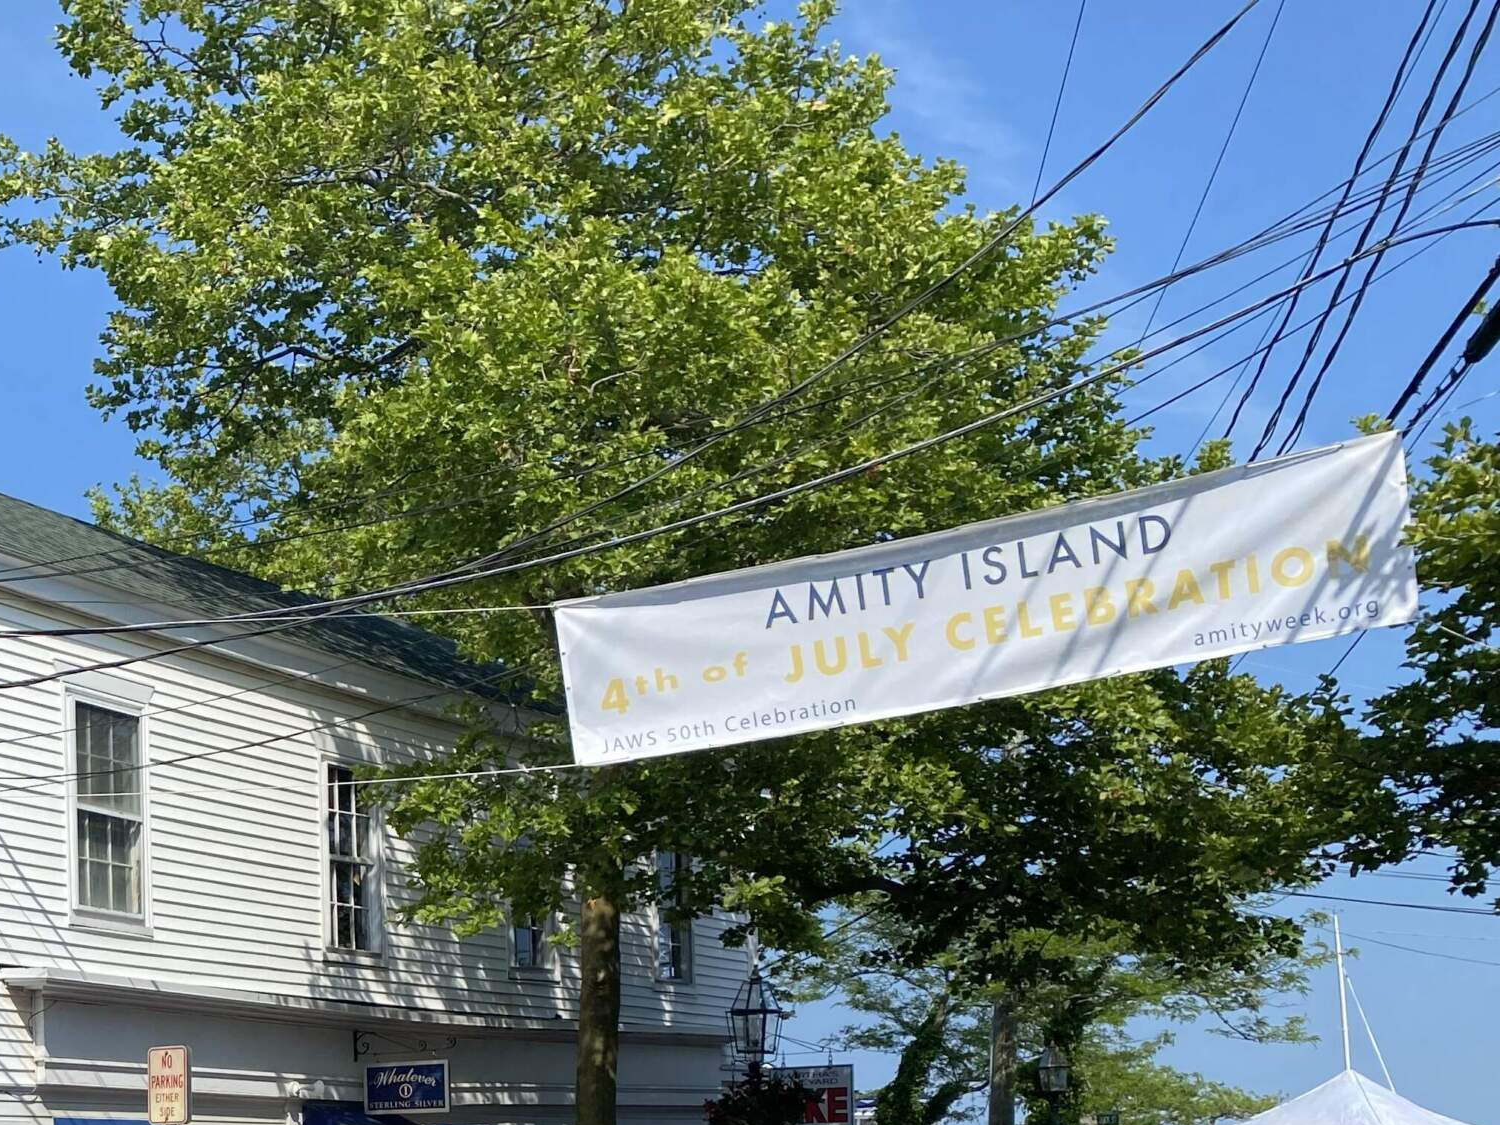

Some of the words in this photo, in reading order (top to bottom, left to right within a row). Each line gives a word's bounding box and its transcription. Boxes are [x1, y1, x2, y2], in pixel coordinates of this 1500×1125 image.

[766, 560, 931, 629] AMITY
[961, 515, 1172, 591] ISLAND
[601, 667, 680, 715] 4th
[702, 651, 749, 683] of
[784, 623, 915, 684] JULY
[945, 534, 1371, 652] CELEBRATION
[1193, 598, 1380, 647] amityweek.org
[602, 730, 658, 754] JAWS
[666, 720, 716, 743] 50th
[724, 697, 857, 733] Celebration
[161, 1055, 172, 1069] NO
[151, 1075, 184, 1089] PARKING
[155, 1093, 180, 1103] EITHER
[369, 1100, 411, 1109] STERLING
[414, 1099, 445, 1108] SILVER
[803, 1087, 849, 1123] KE
[159, 1107, 175, 1117] SIDE
